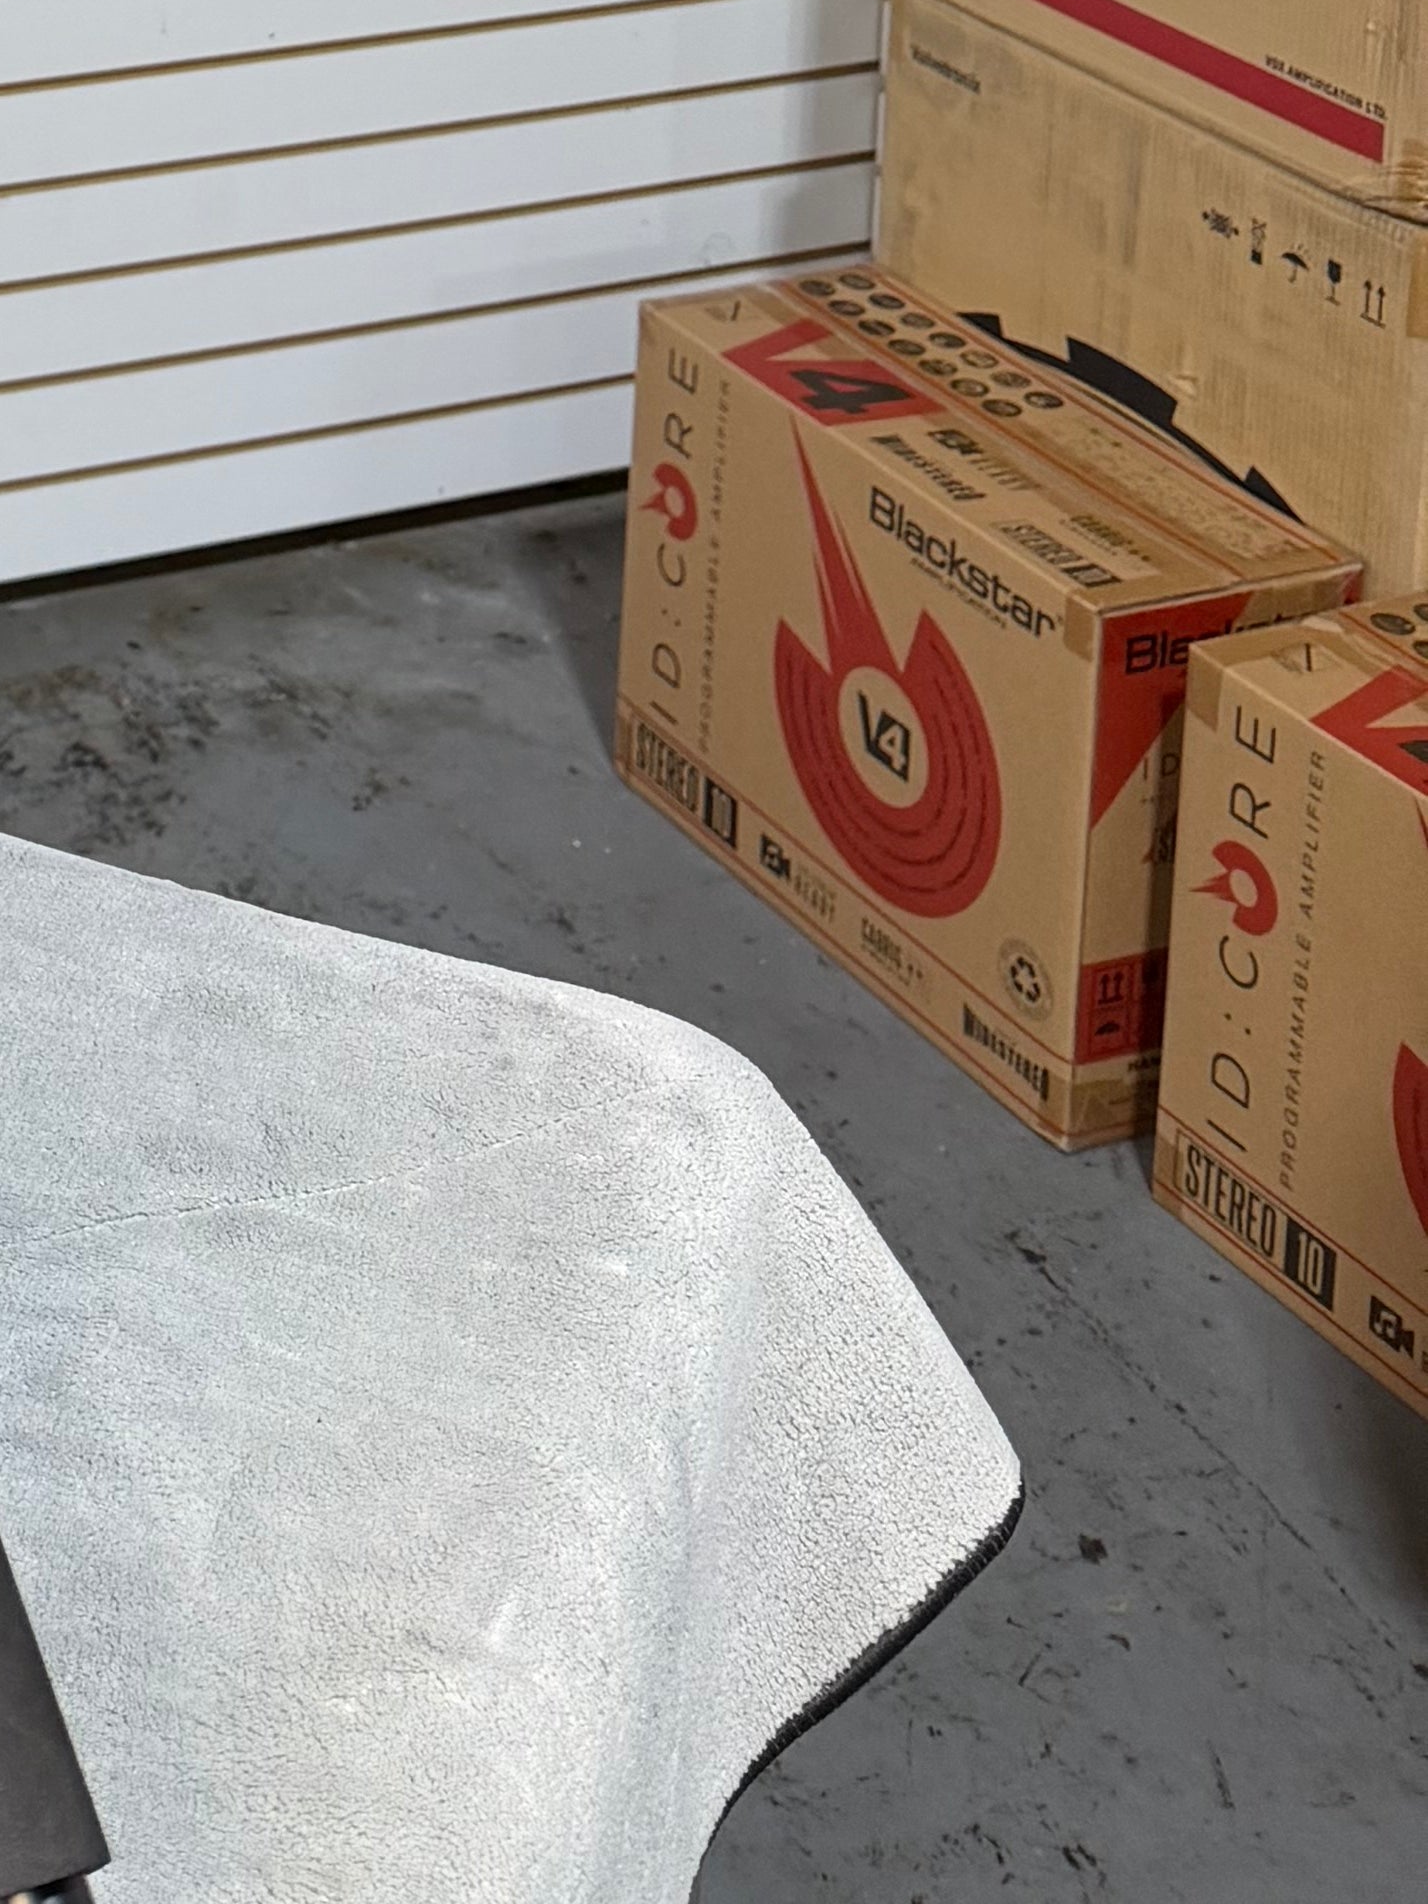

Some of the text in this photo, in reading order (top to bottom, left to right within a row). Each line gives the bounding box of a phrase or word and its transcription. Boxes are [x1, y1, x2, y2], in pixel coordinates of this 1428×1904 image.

[869, 484, 1056, 639] Blackstar
[1278, 749, 1326, 1191] PROGRAMMABLE AMPLIFIER
[1185, 1144, 1325, 1296] STEREO 10
